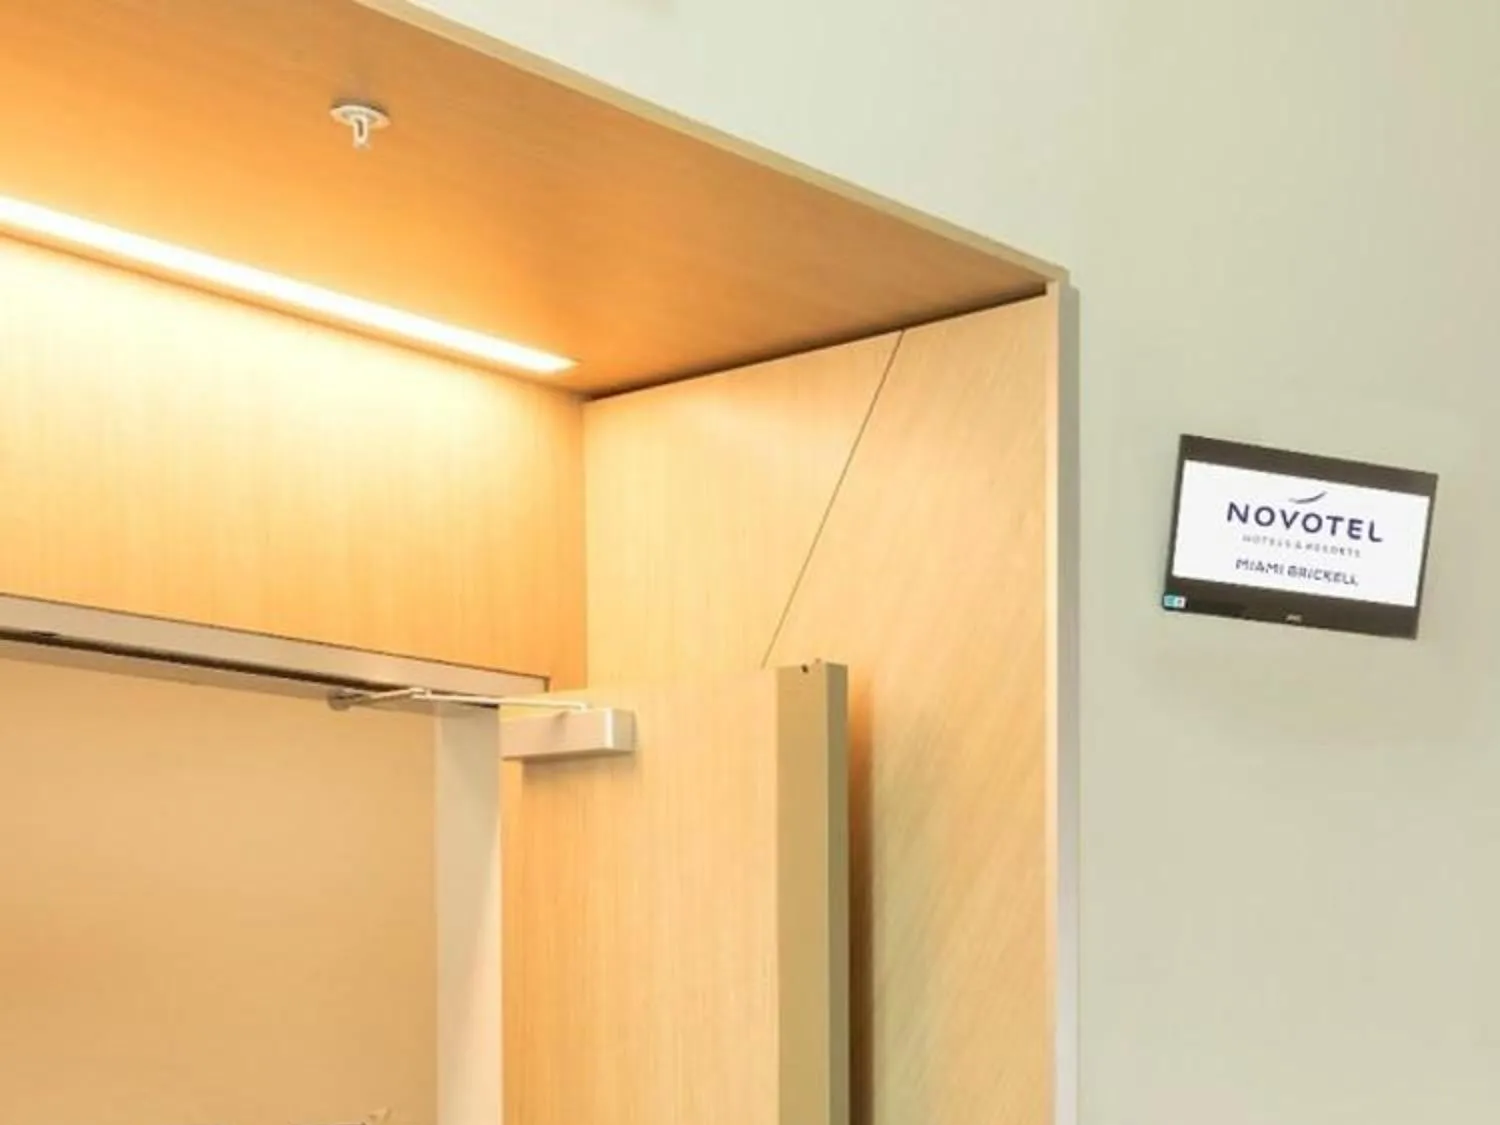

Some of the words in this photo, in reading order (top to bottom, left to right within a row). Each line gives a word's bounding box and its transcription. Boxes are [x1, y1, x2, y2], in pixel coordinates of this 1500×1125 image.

[1226, 501, 1383, 543] NOVOTEL
[1235, 558, 1285, 575] MIAMI
[1287, 565, 1359, 586] BRICKELL
